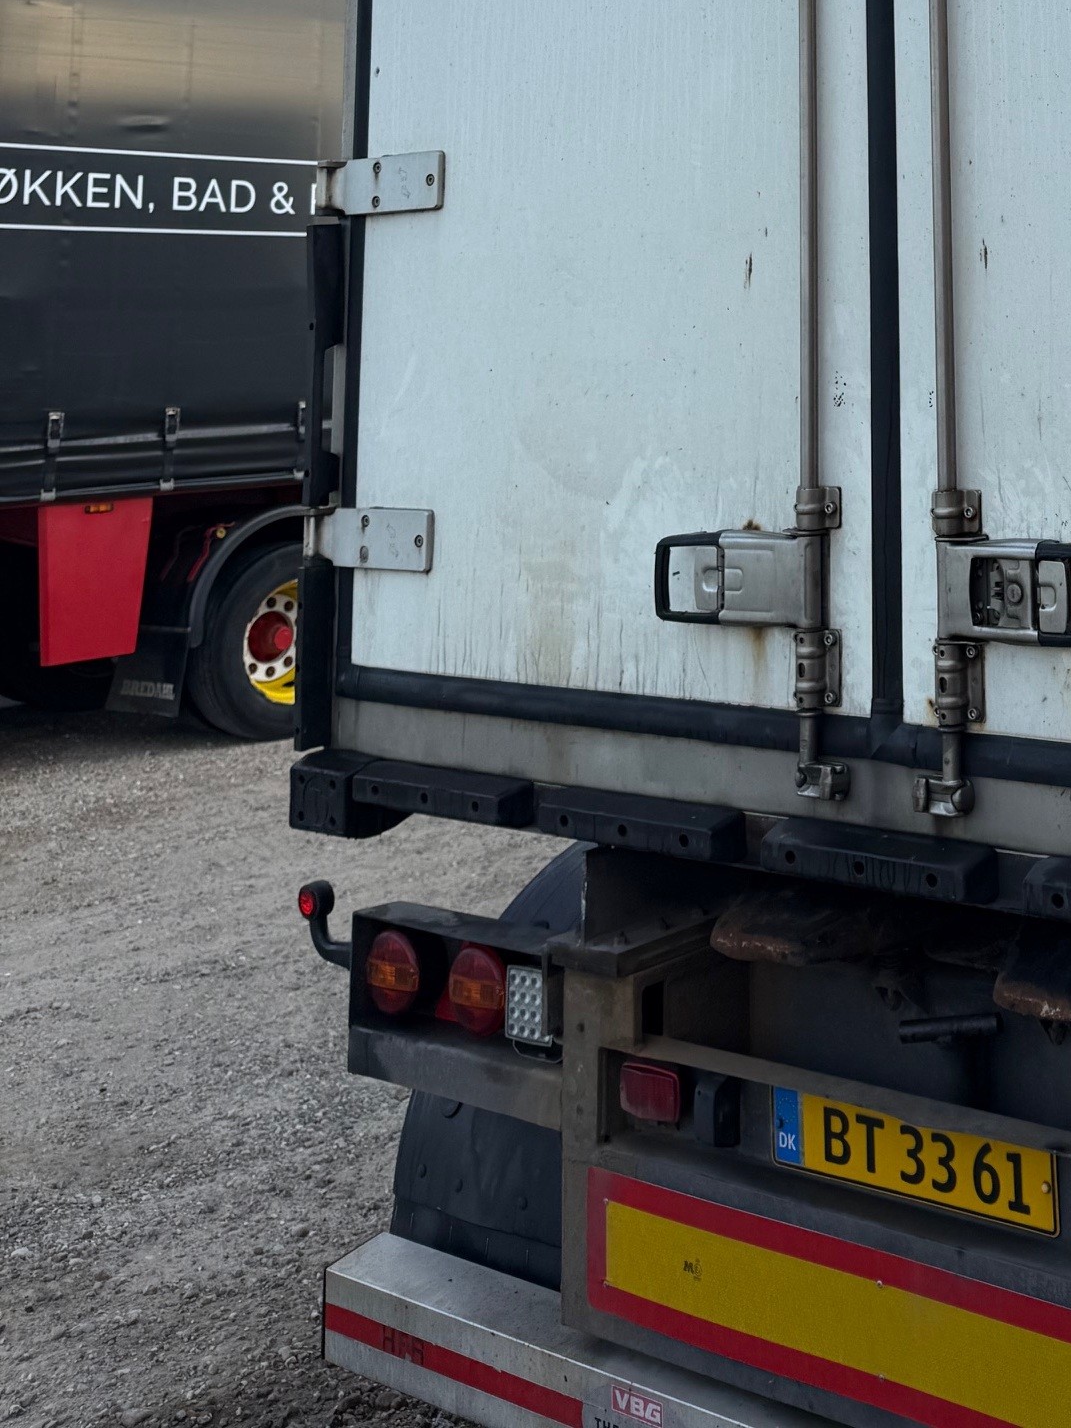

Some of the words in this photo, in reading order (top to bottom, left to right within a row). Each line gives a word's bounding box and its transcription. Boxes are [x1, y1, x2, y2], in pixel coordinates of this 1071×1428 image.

[172, 176, 256, 214] BAD
[269, 181, 296, 216] &
[778, 1131, 797, 1152] DK
[823, 1105, 885, 1174] BT
[899, 1124, 957, 1194] 33
[972, 1142, 1031, 1216] 61
[615, 1389, 661, 1425] VBG
